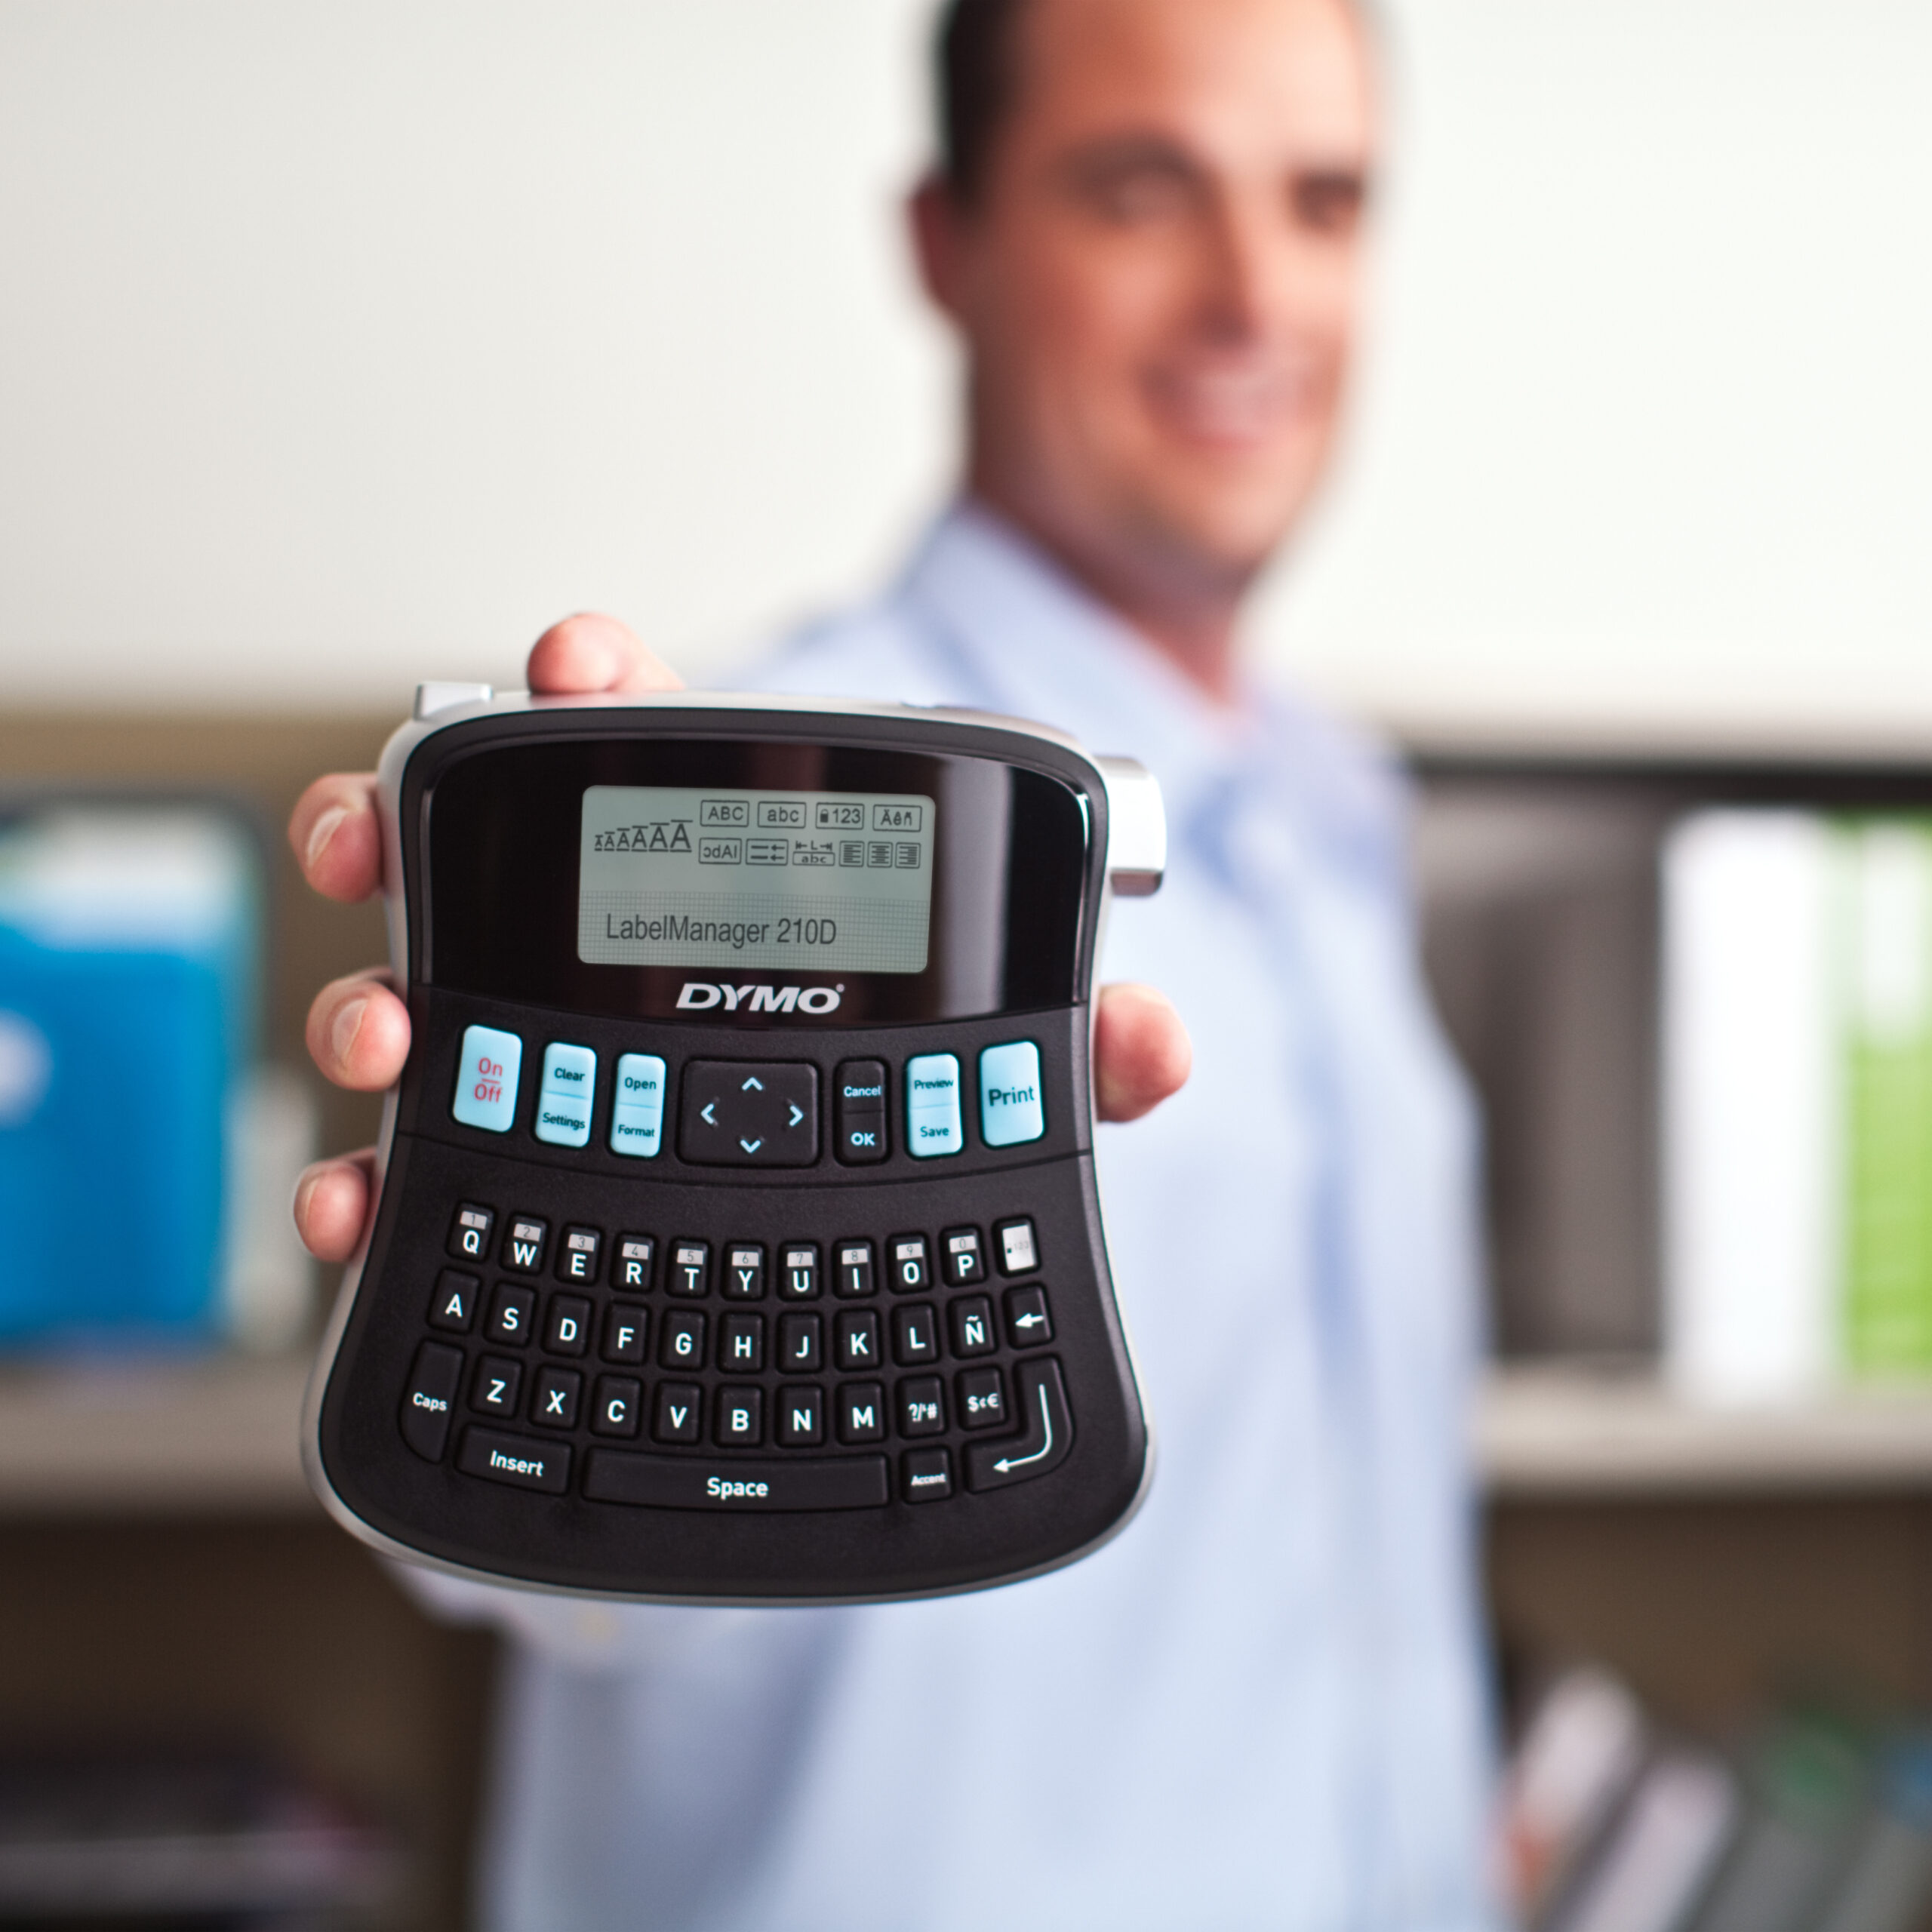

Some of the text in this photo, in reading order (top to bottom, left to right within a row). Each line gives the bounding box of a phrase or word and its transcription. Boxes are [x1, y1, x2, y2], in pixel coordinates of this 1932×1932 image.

[708, 806, 744, 821] ABC
[767, 806, 799, 823] abc
[832, 808, 861, 824] 123
[801, 854, 827, 864] abc
[607, 914, 837, 949] LabelManager 210D
[478, 1057, 503, 1076] On
[555, 1068, 585, 1081] Clear
[474, 1084, 502, 1103] Off
[625, 1077, 656, 1091] Open
[844, 1086, 881, 1097] Cancel
[914, 1078, 953, 1089] Preview
[988, 1086, 1035, 1106] Print
[543, 1112, 585, 1131] Settings
[618, 1124, 654, 1137] Format
[851, 1133, 874, 1146] OK
[921, 1127, 949, 1137] Save
[470, 1214, 477, 1225] 1
[523, 1226, 531, 1238] 2
[463, 1231, 478, 1254] Q
[577, 1237, 585, 1248] 3
[631, 1246, 638, 1257] 4
[906, 1245, 914, 1256] 9
[959, 1238, 967, 1249] 0
[513, 1241, 537, 1266] W
[687, 1251, 694, 1262] 5
[742, 1253, 749, 1265] 6
[796, 1253, 804, 1265] 7
[851, 1251, 859, 1262] 8
[571, 1254, 586, 1275] E
[626, 1263, 641, 1284] R
[903, 1263, 919, 1284] O
[958, 1255, 973, 1276] P
[685, 1269, 699, 1289] T
[739, 1271, 752, 1291] Y
[793, 1271, 808, 1292] U
[854, 1269, 859, 1289] I
[446, 1294, 462, 1316] A
[503, 1308, 518, 1330] S
[560, 1318, 576, 1340] D
[618, 1327, 633, 1348] F
[910, 1327, 925, 1349] L
[966, 1316, 983, 1345] Ñ
[676, 1334, 691, 1355] G
[735, 1337, 751, 1357] H
[796, 1337, 808, 1358] J
[851, 1333, 868, 1355] K
[488, 1380, 505, 1402] Z
[414, 1393, 446, 1411] Caps
[547, 1391, 565, 1414] X
[608, 1401, 625, 1422] C
[671, 1407, 686, 1428] V
[732, 1410, 748, 1431] B
[794, 1410, 811, 1431] N
[853, 1407, 873, 1428] M
[491, 1451, 543, 1476] Insert
[708, 1478, 768, 1500] Space
[912, 1474, 946, 1485] Accent
